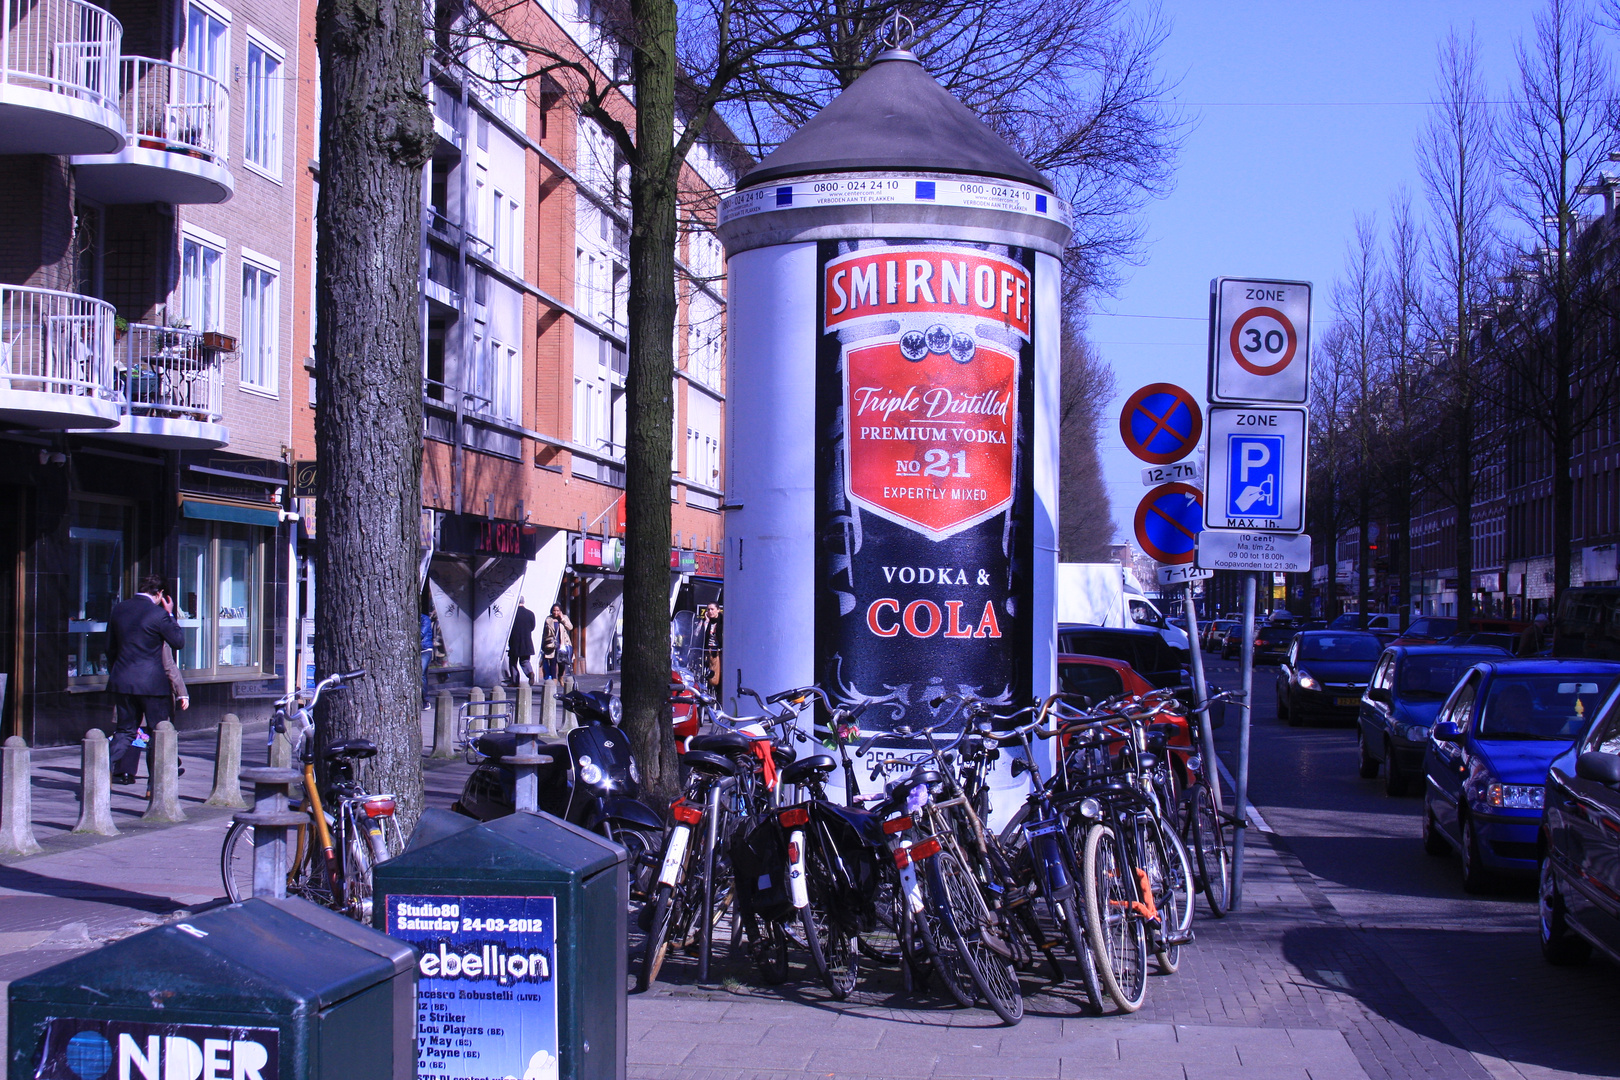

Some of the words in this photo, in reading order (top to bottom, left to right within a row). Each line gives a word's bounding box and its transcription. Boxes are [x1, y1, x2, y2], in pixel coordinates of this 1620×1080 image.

[813, 182, 839, 192] 0800
[847, 181, 866, 190] 024
[870, 180, 883, 190] 24
[887, 180, 899, 190] 10
[960, 183, 984, 194] 0800
[991, 186, 1007, 196] 024
[1010, 188, 1019, 198] 24
[1022, 191, 1031, 200] 10
[746, 193, 754, 202] 24
[755, 190, 764, 200] 10
[963, 199, 990, 207] VERBODEN
[831, 259, 1027, 322] SMIRNOFF
[1245, 288, 1285, 302] ZONE
[1243, 328, 1284, 354] 30
[854, 386, 919, 422] Triple
[923, 387, 1011, 425] Distilled
[1236, 414, 1278, 427] ZONE
[860, 426, 946, 442] PREMIUM
[951, 427, 1007, 445] VODKA
[896, 460, 921, 475] NO
[924, 448, 971, 478] 21
[1240, 442, 1271, 483] P
[1148, 464, 1194, 482] 12-7h
[883, 486, 947, 500] EXPERTLY
[951, 488, 988, 501] MIXED
[1227, 518, 1259, 529] MAX.
[1264, 519, 1280, 528] 1h.
[1239, 534, 1251, 543] (10
[1253, 535, 1275, 543] cent)
[1250, 552, 1259, 560] tot
[1261, 553, 1285, 561] 18.00h
[1214, 559, 1263, 569] Koopavonden
[1263, 561, 1273, 569] tot
[1274, 561, 1298, 570] 21.30h
[882, 566, 969, 586] VODKA
[976, 568, 991, 586] &
[866, 598, 1003, 639] COLA
[397, 903, 460, 918] Studio80
[397, 916, 460, 934] Saturday
[462, 917, 543, 933] 24-03-2012
[419, 943, 549, 983] ebellion
[418, 990, 456, 1000] ncesco
[459, 989, 514, 1001] Robustelli
[516, 993, 542, 1002] (LIVE)
[430, 1003, 448, 1012] (BE)
[429, 1012, 466, 1023] Striker
[419, 1023, 439, 1034] Lou
[443, 1024, 484, 1036] Players
[486, 1028, 505, 1037] (BE)
[429, 1035, 452, 1048] May
[455, 1038, 472, 1047] (BE)
[426, 1047, 460, 1059] Payne
[463, 1050, 481, 1059] (BE)
[429, 1061, 447, 1070] (BE)
